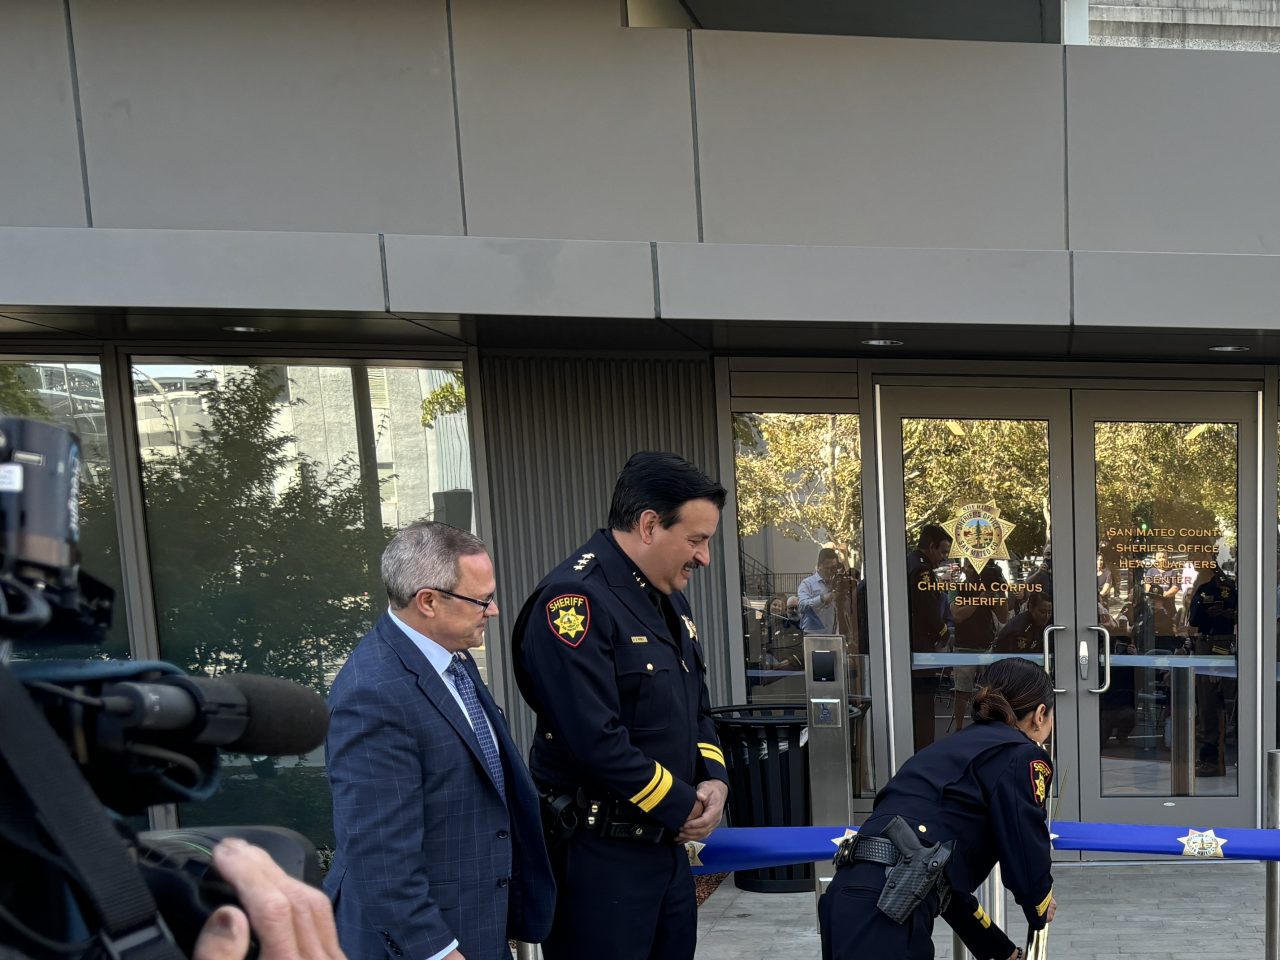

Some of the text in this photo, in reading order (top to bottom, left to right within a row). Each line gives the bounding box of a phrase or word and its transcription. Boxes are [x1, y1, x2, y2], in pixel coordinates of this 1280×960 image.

[1109, 528, 1132, 537] SAN
[1137, 528, 1176, 537] MATEO
[1116, 543, 1219, 553] SHERIFF'S OFFICE
[1119, 560, 1217, 569] HEADQUARTERS
[1144, 576, 1192, 585] CENTER
[917, 581, 1043, 593] CHRISTINA CORPUS
[549, 597, 584, 612] SHERIFF
[954, 596, 1007, 606] SHERIFF
